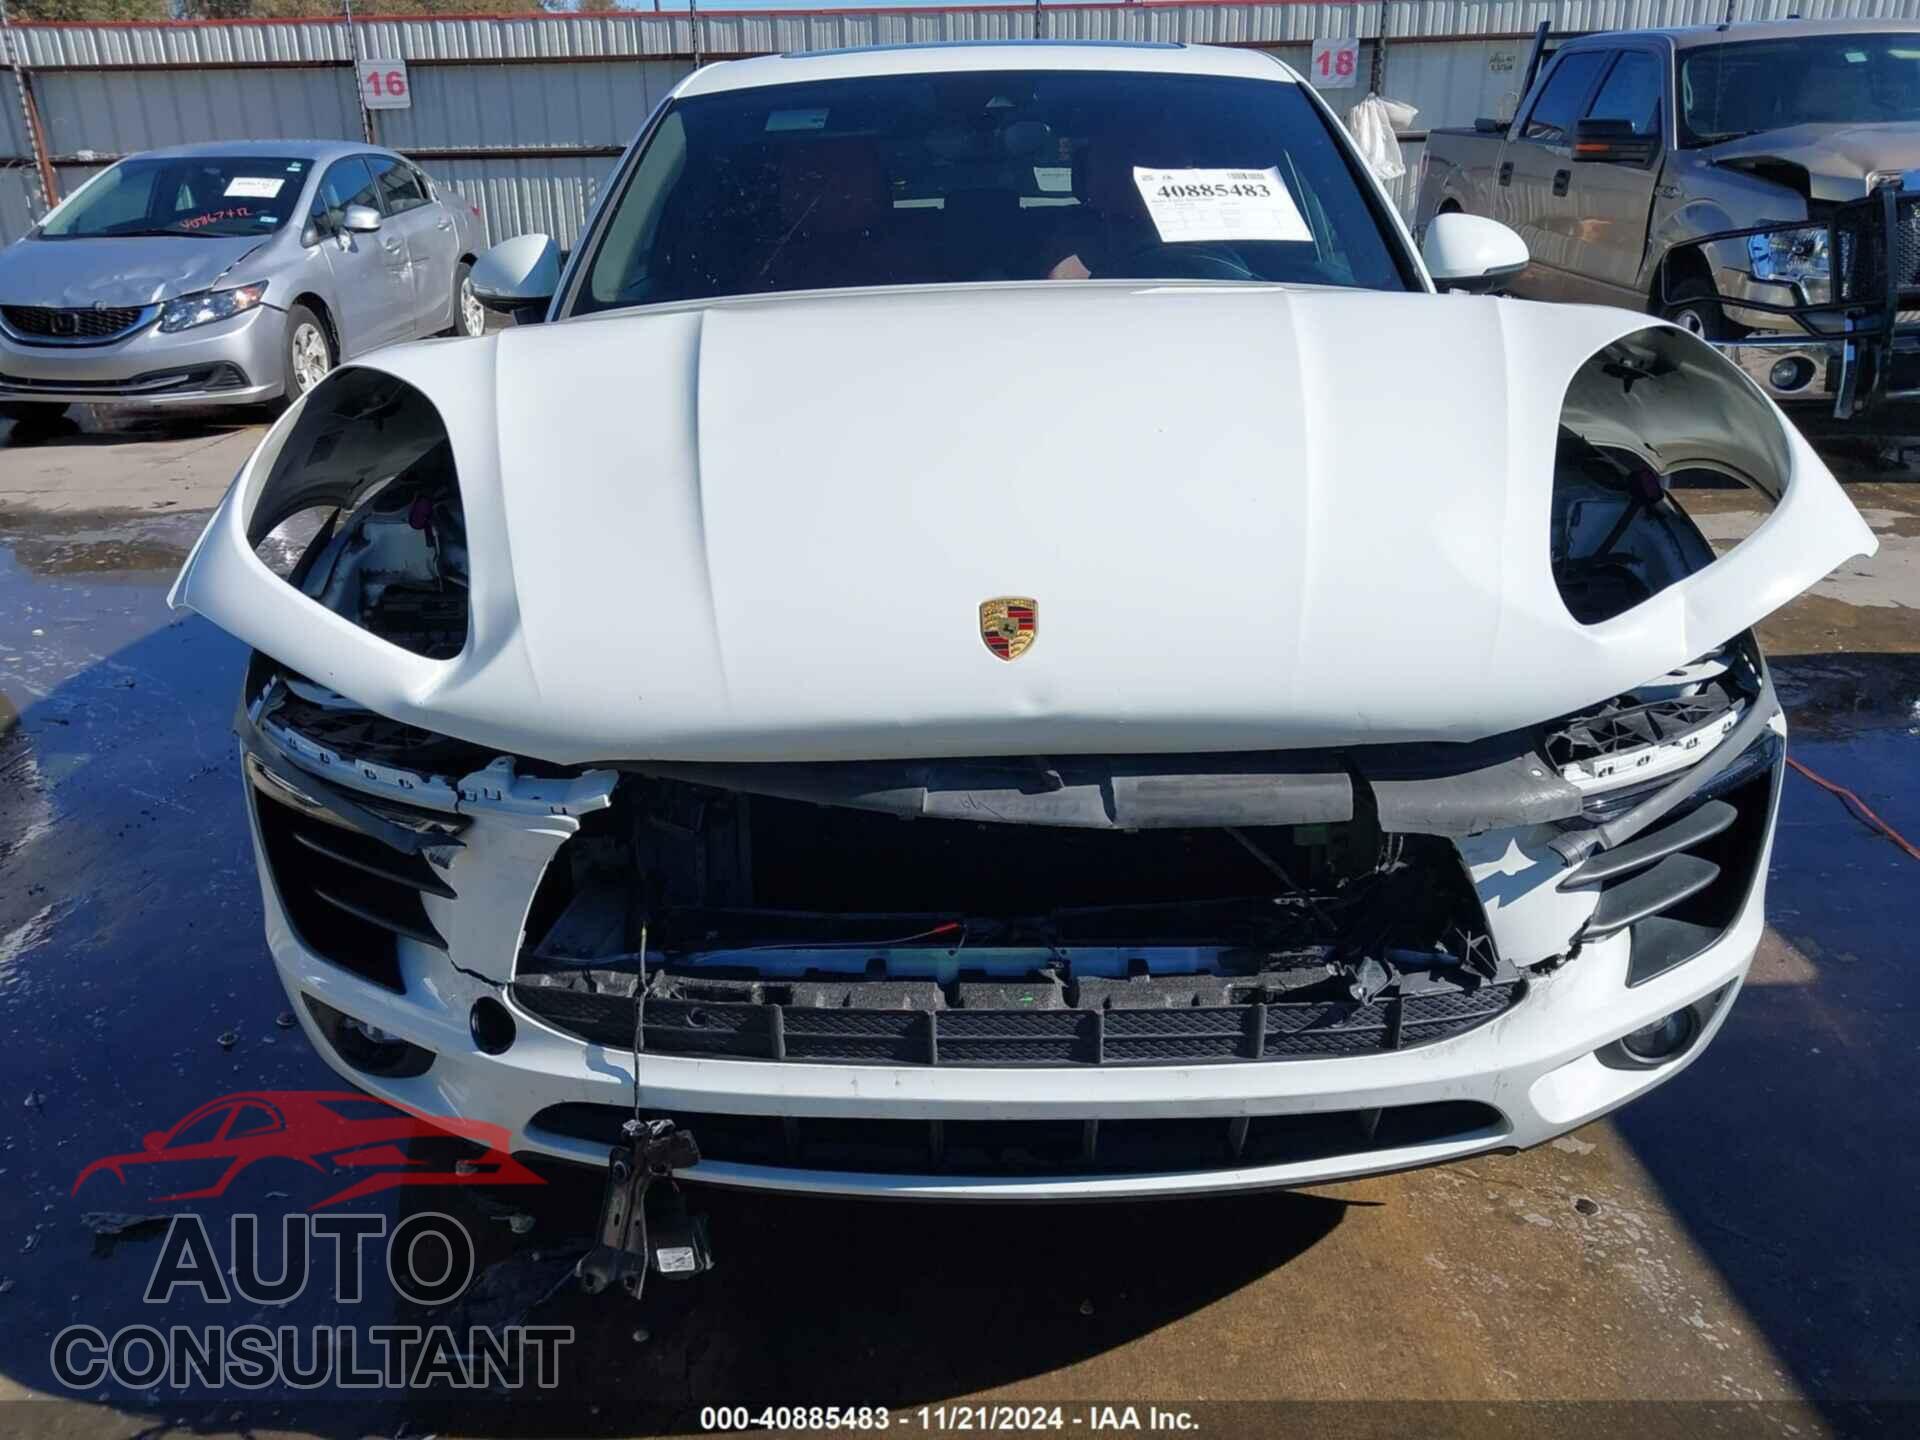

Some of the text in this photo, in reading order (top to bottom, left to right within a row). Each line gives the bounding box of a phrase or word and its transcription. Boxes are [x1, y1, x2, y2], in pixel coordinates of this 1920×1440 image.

[1316, 51, 1354, 76] 18
[367, 71, 405, 97] 16
[1157, 184, 1271, 199] 40885483
